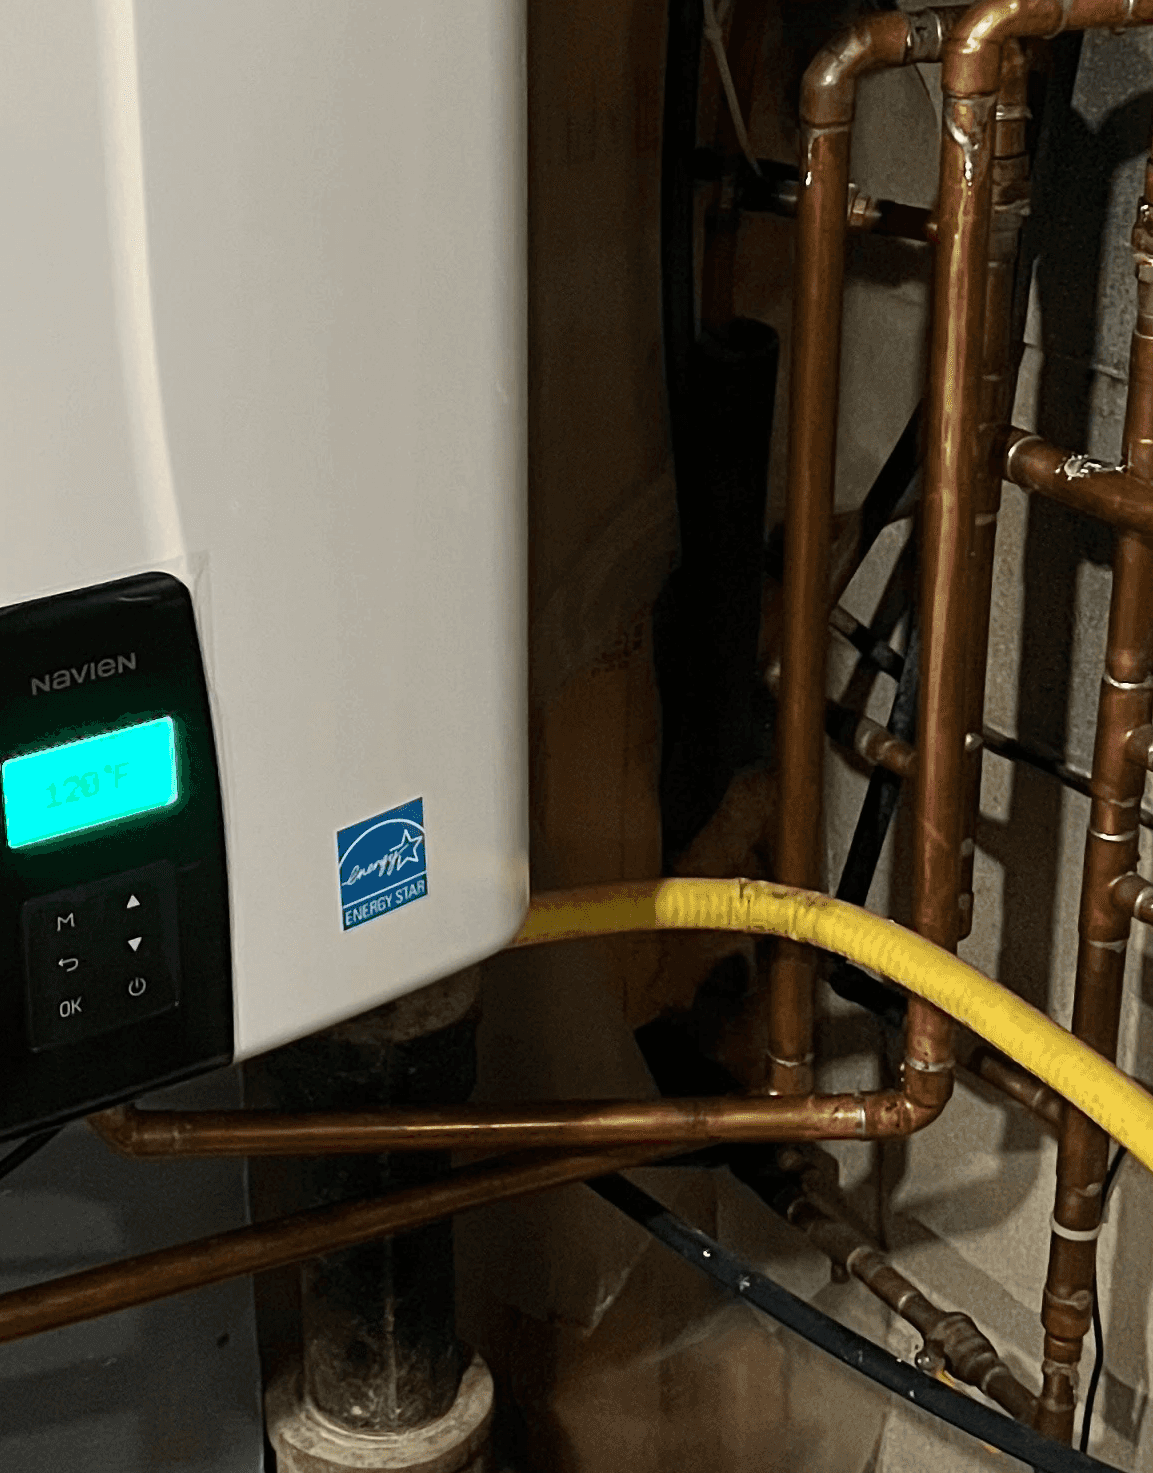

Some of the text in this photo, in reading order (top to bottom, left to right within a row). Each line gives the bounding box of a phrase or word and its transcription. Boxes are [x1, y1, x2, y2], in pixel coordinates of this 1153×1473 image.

[345, 879, 425, 927] ENERGY STAR
[57, 912, 75, 932] M
[59, 996, 83, 1018] OK
